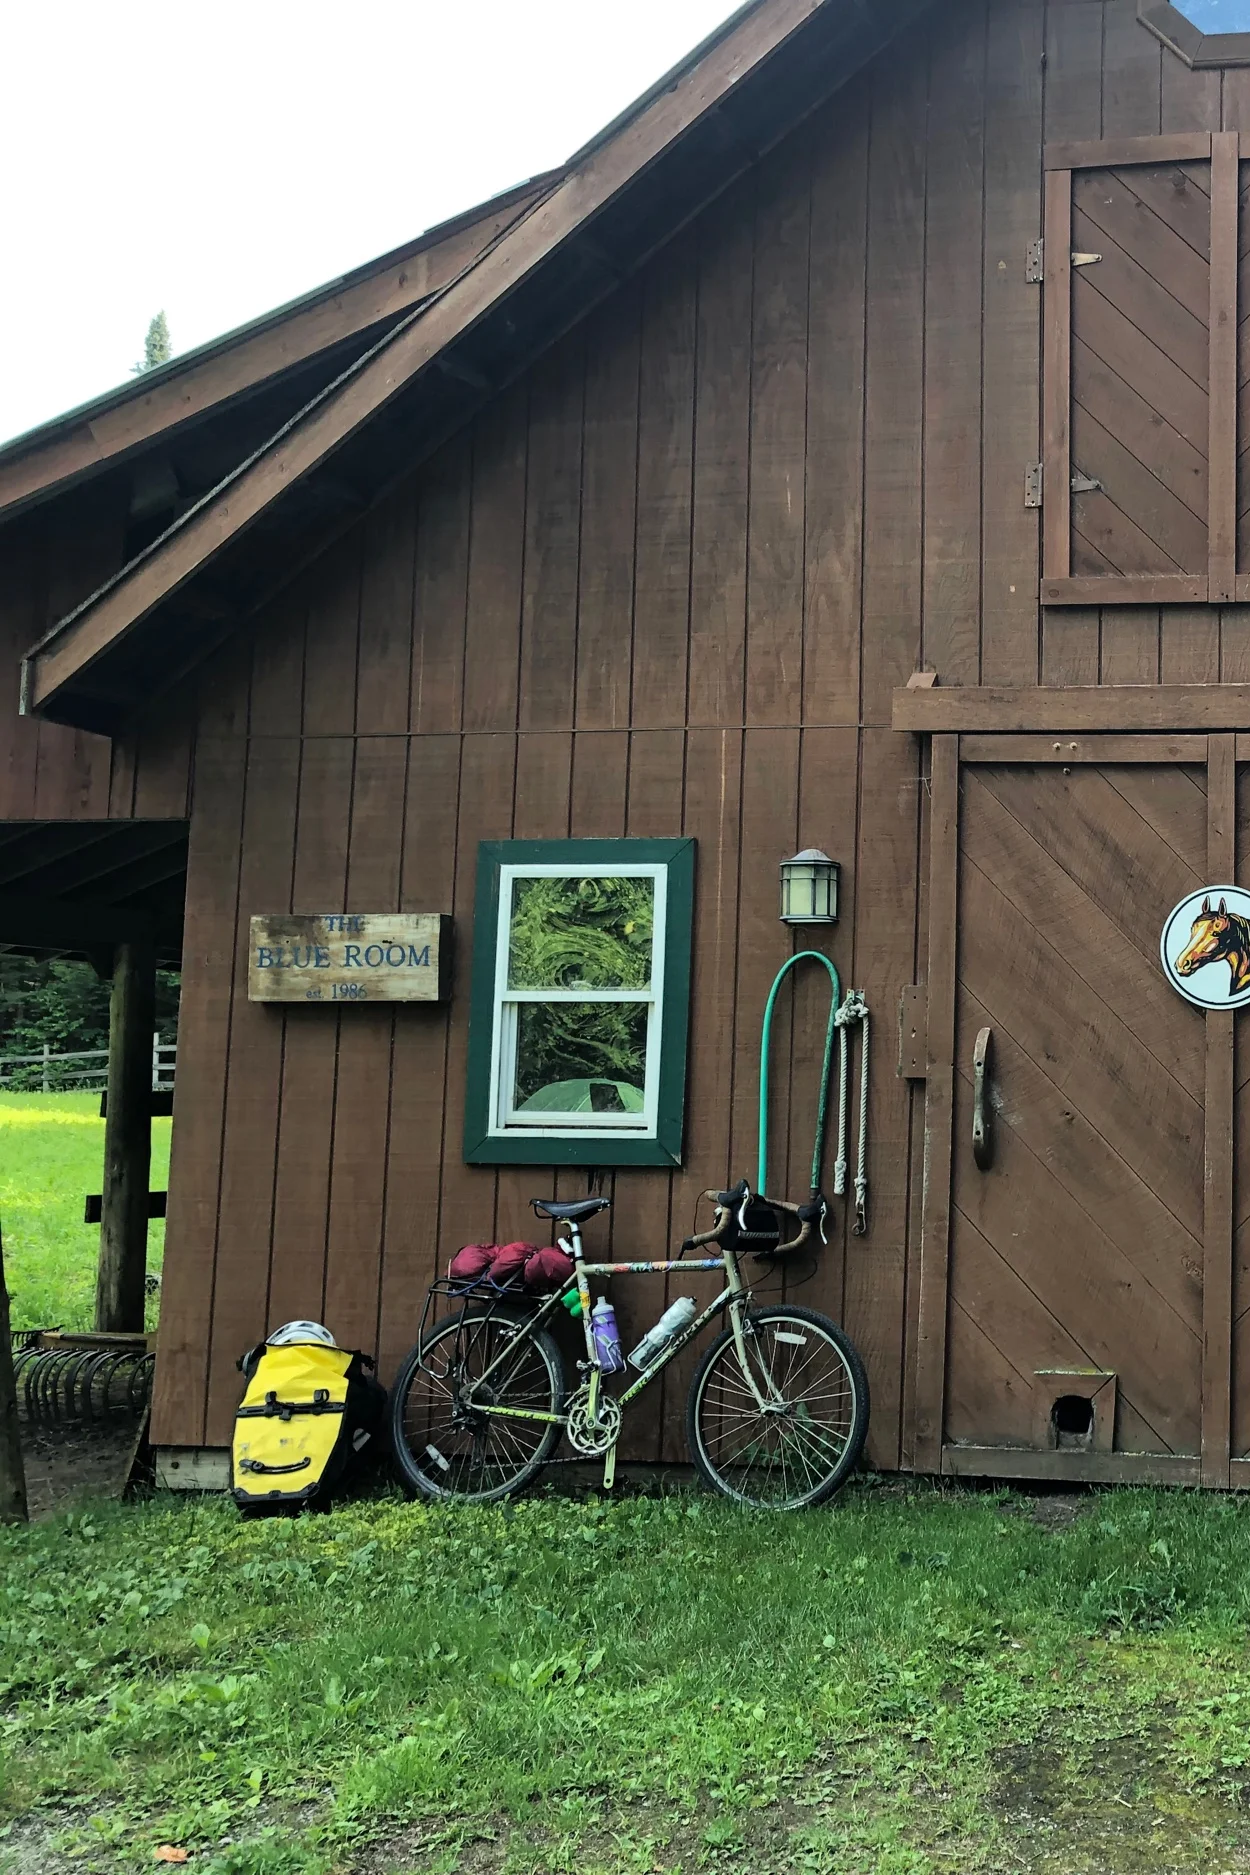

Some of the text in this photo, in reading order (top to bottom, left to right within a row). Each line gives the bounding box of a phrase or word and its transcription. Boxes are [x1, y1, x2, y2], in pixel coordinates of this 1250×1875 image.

[325, 915, 366, 932] THE
[256, 944, 431, 969] BLUE ROOM
[306, 983, 368, 999] est. 1986
[617, 1376, 649, 1406] TREK
